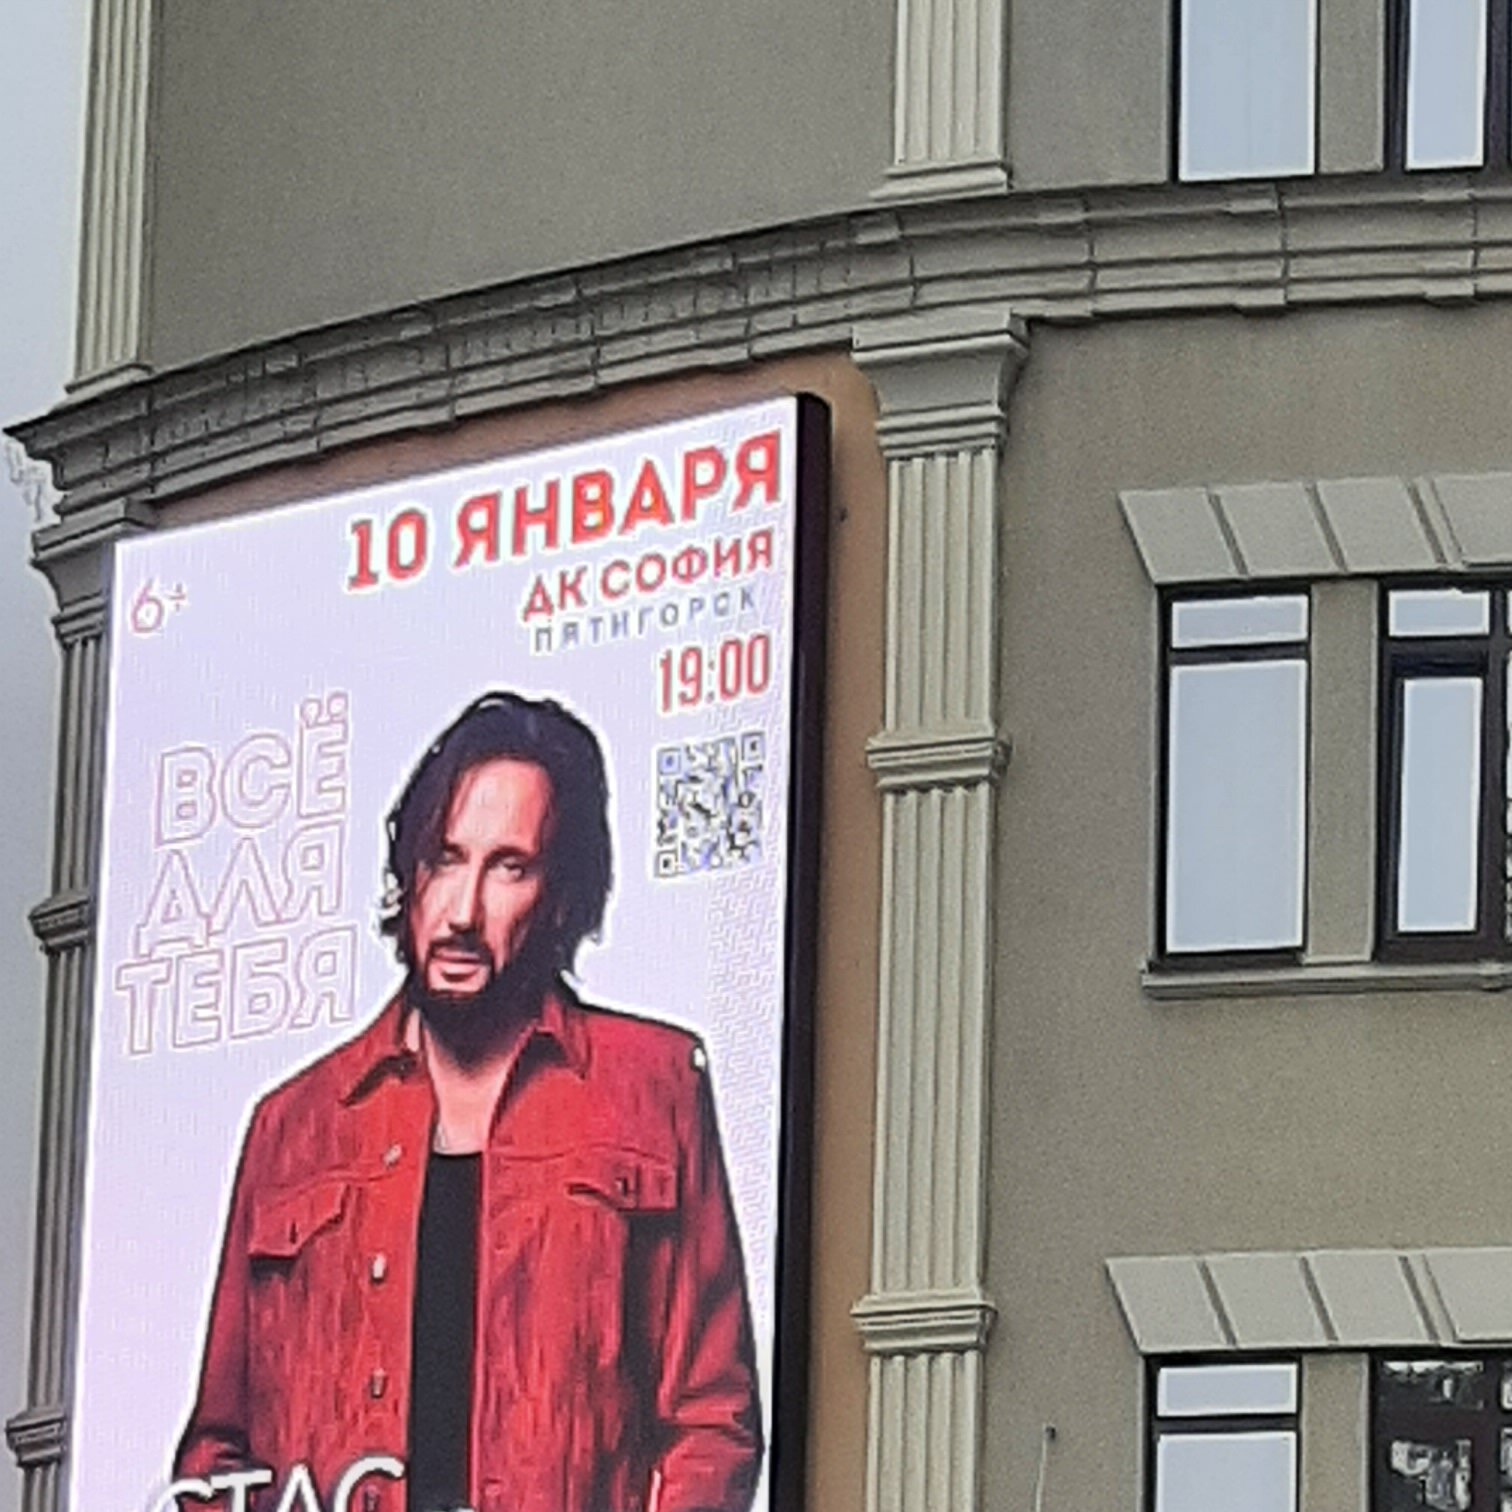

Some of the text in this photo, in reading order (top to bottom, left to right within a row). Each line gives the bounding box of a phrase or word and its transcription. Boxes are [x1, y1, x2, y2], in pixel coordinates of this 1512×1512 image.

[348, 430, 782, 591] 10 ЯНВАРЯ
[130, 578, 187, 634] 6+
[523, 527, 775, 622] ДК СОФИЯ
[534, 585, 755, 653] ПЯТИГОРСК
[658, 633, 772, 714] 19:00
[153, 690, 350, 849] ВСЁ
[135, 821, 346, 960] ДЛЯ
[114, 926, 359, 1056] ТЕБЯ
